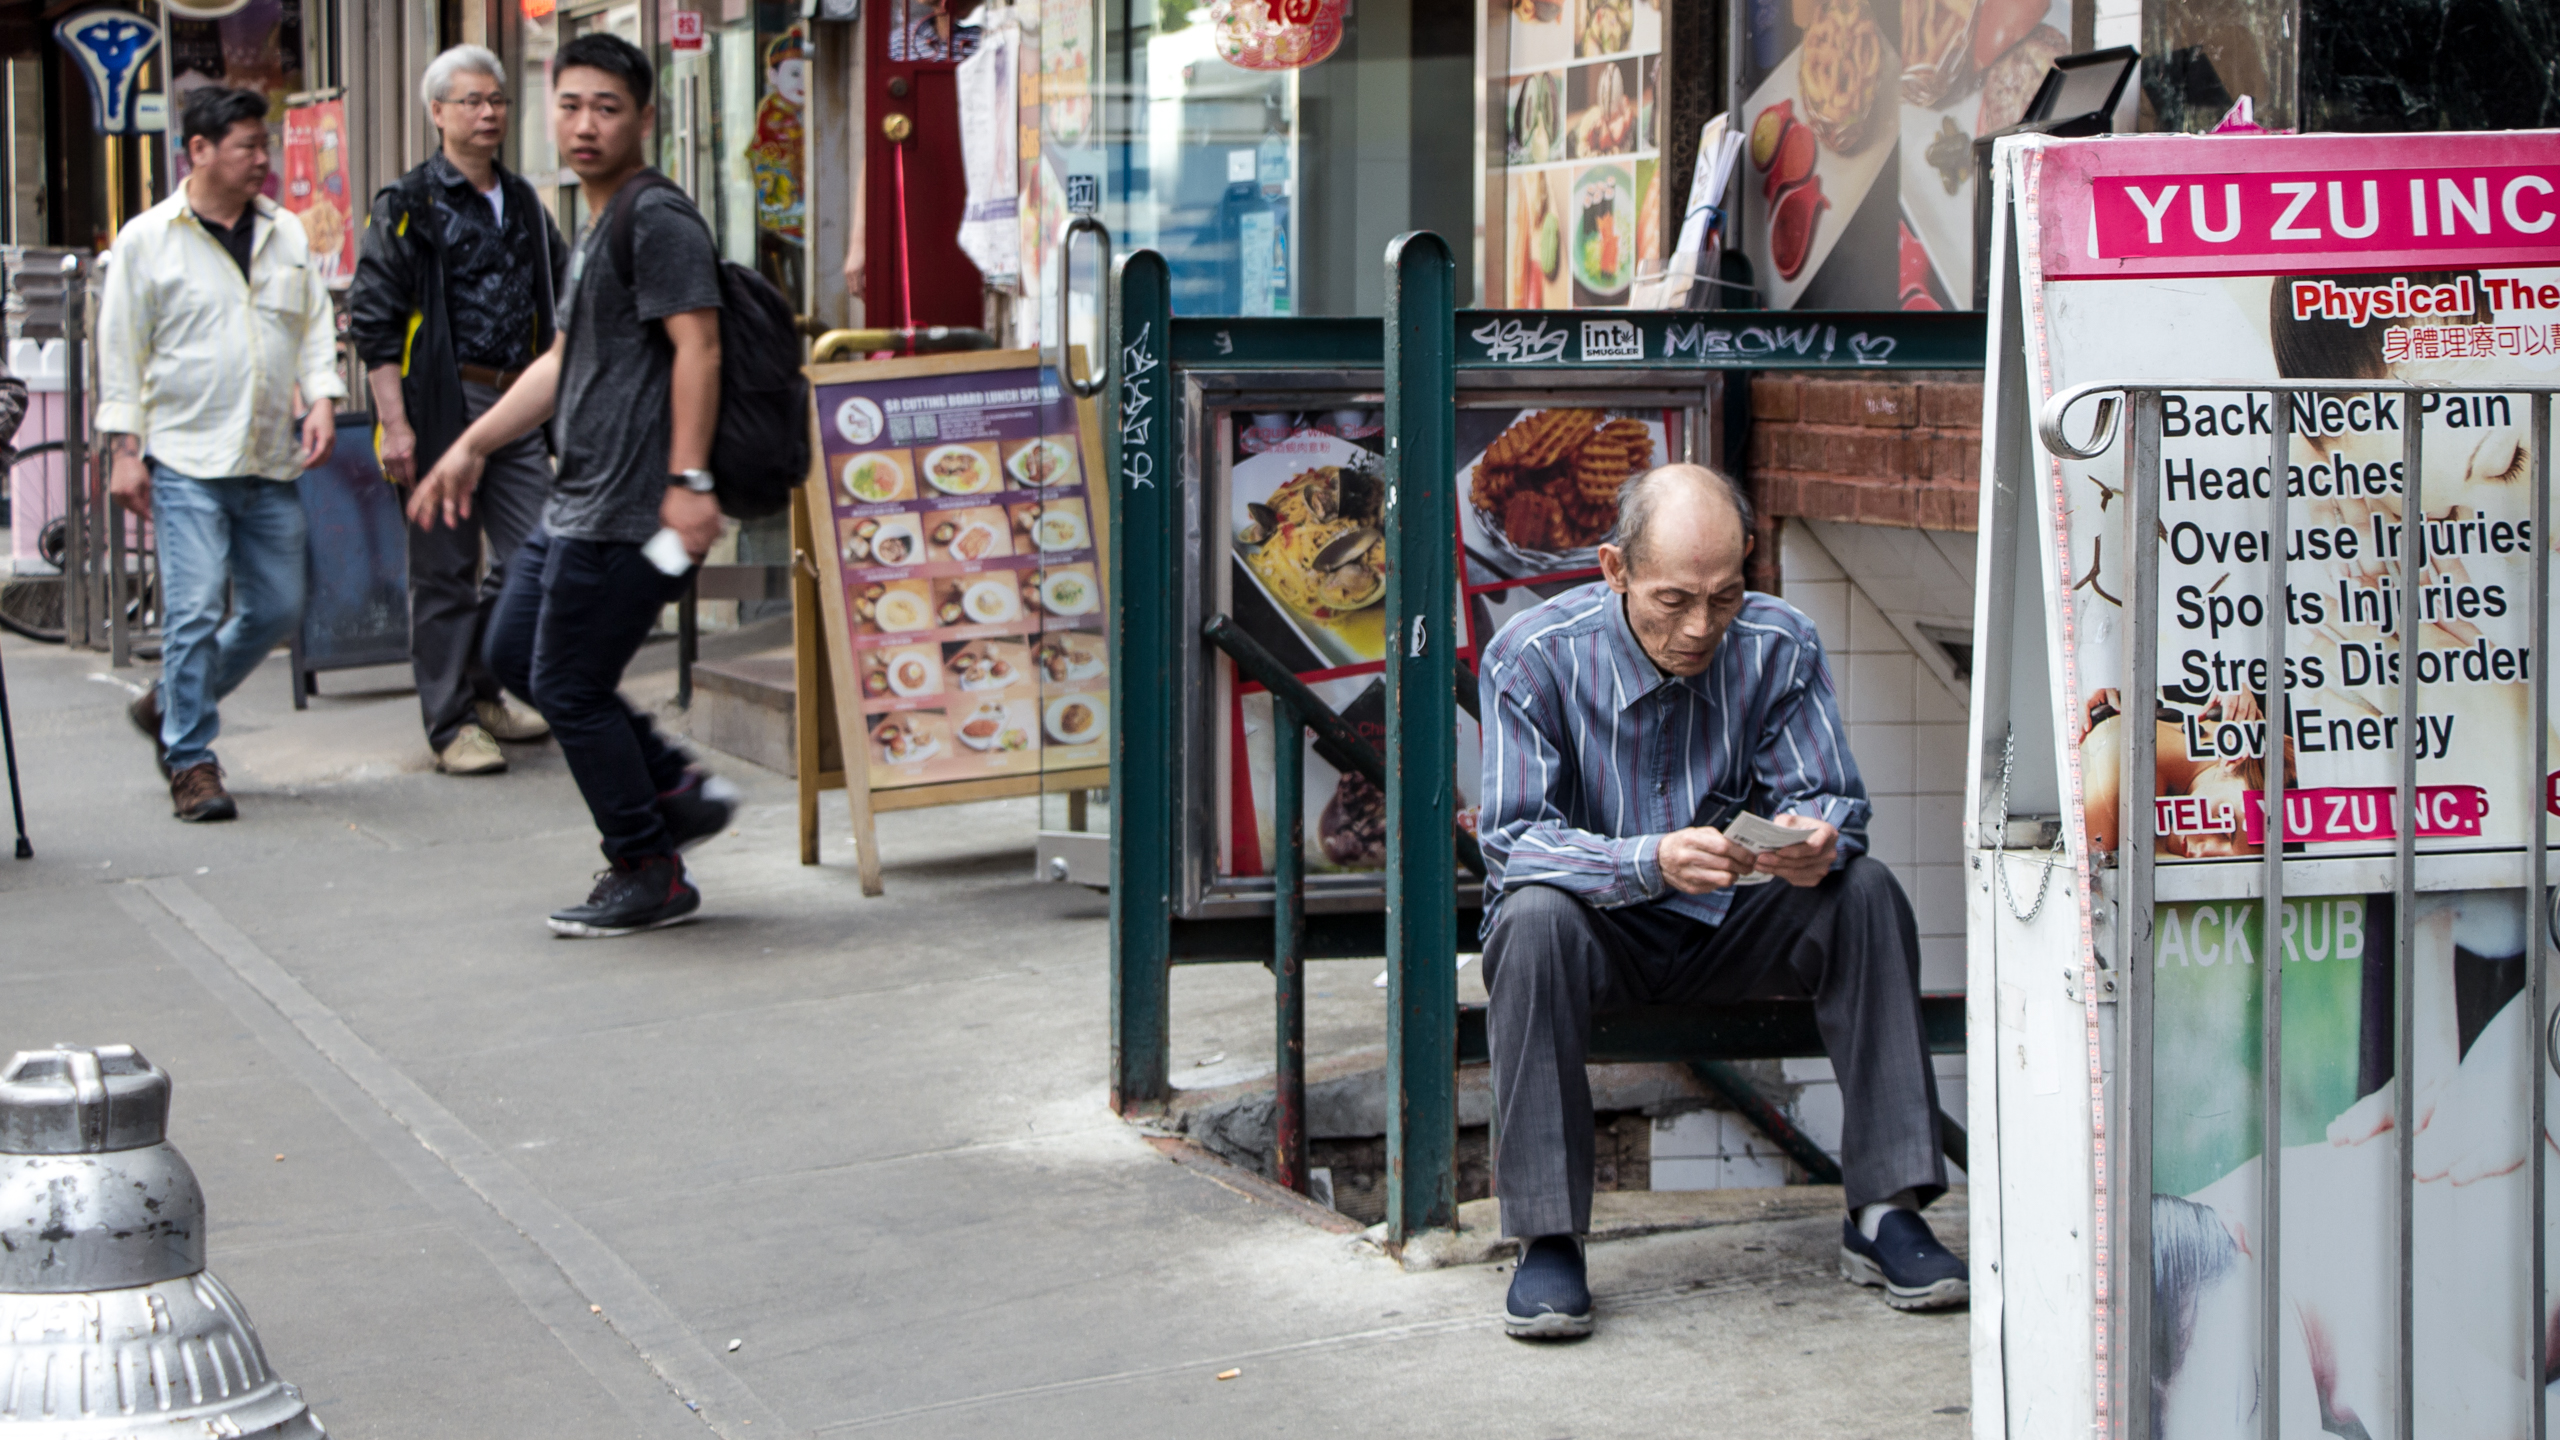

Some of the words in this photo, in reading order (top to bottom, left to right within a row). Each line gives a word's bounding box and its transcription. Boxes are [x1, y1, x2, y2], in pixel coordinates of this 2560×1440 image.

[2124, 182, 2242, 244] YU
[2270, 179, 2380, 242] ZU
[2410, 175, 2557, 238] INC
[2296, 280, 2470, 325] Physical
[2484, 278, 2560, 310] The
[1586, 348, 1639, 357] SMUGGLER
[1239, 424, 1303, 442] Linguine
[1306, 424, 1337, 438] with
[2162, 393, 2271, 437] Back
[2290, 392, 2400, 434] Neck
[2166, 453, 2404, 502] Headaches
[2176, 583, 2325, 639] Spots
[2340, 576, 2507, 634] Injries
[2182, 648, 2325, 694] Stress
[2156, 799, 2231, 831] TEL:
[2257, 797, 2313, 836] U
[2324, 795, 2378, 834] ZU
[2157, 905, 2255, 968] ACK
